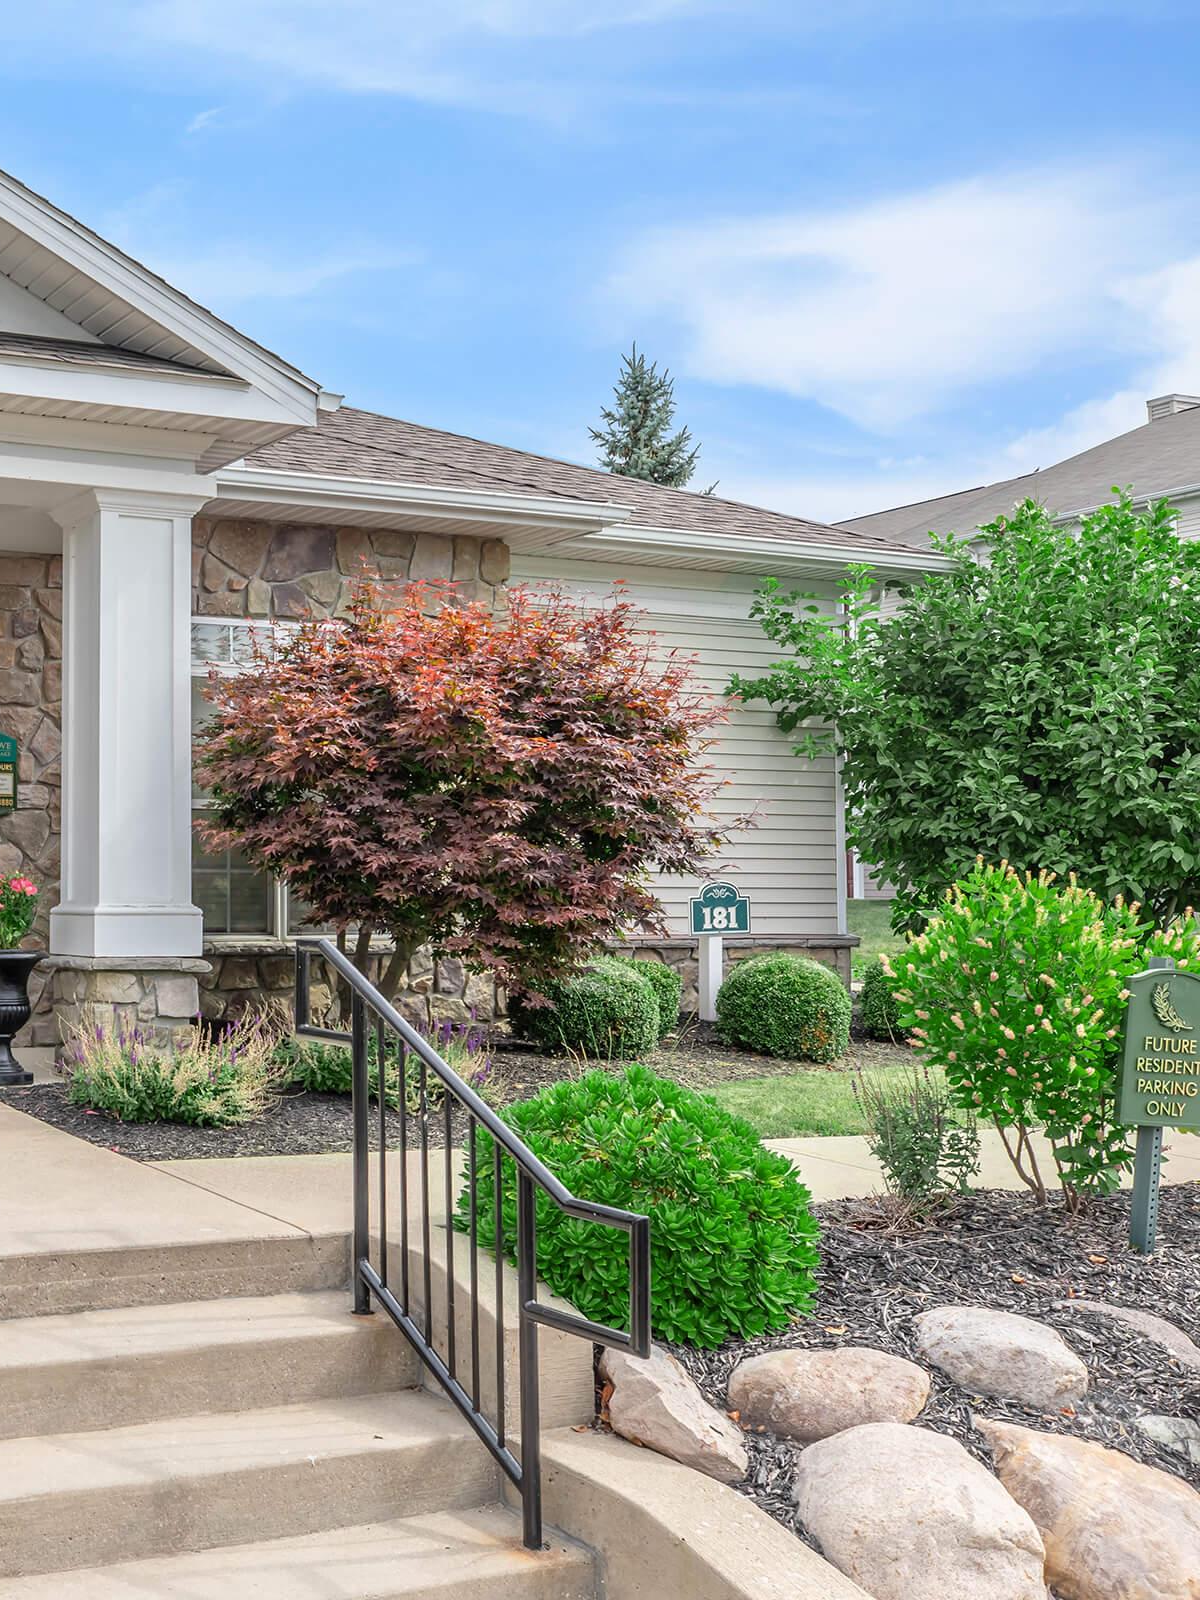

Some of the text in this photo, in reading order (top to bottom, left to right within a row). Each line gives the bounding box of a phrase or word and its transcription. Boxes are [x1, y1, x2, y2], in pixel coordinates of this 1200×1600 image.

[702, 906, 738, 929] 181
[1145, 1036, 1197, 1053] FUTURE
[1136, 1056, 1200, 1075] RESIDENT
[1137, 1078, 1199, 1097] PARKING
[1146, 1100, 1186, 1117] ONLY
